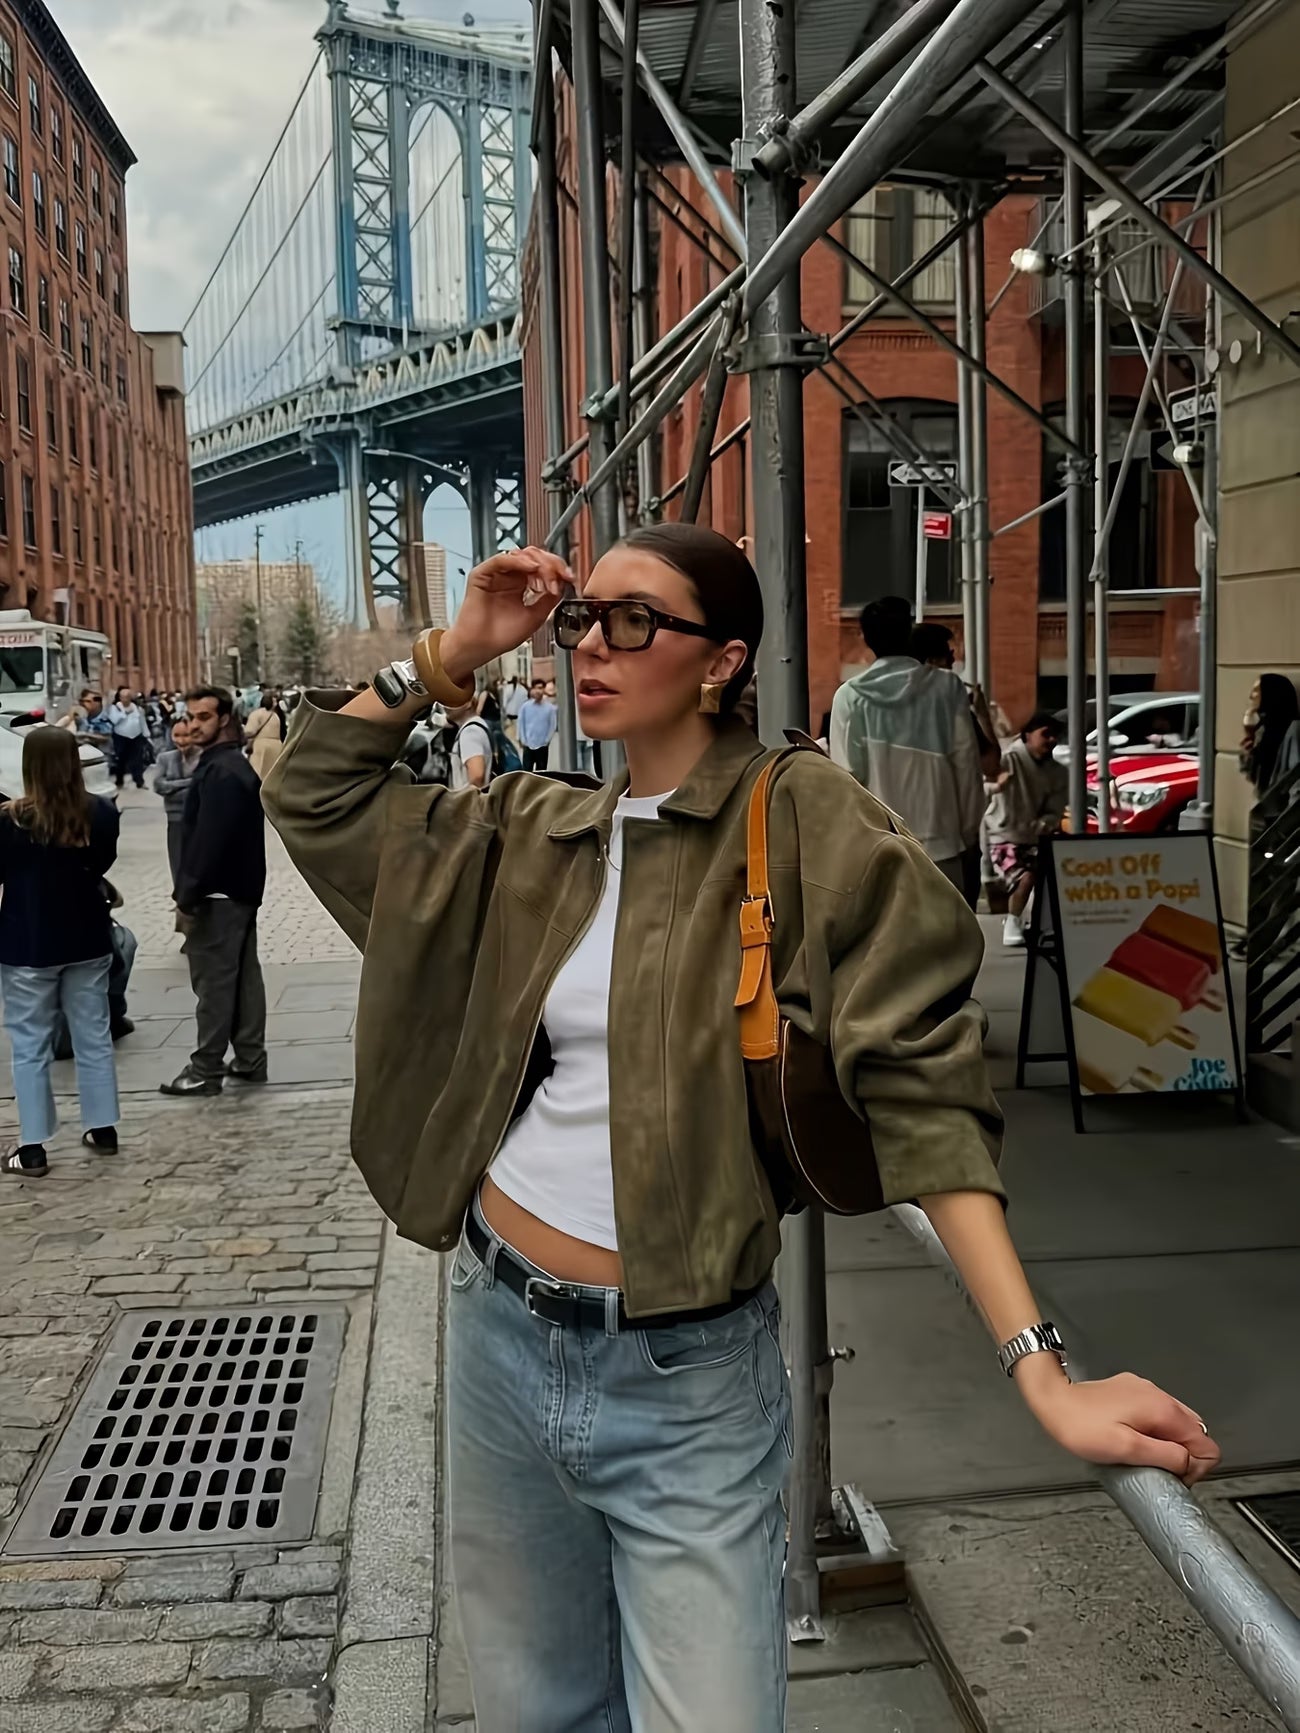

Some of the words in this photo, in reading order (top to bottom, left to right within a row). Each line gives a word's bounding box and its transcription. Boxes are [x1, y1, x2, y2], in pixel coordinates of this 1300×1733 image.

[1061, 857, 1113, 877] Cool
[1120, 852, 1161, 875] Off
[1065, 880, 1119, 902] with
[1126, 885, 1140, 899] a
[1188, 1058, 1226, 1079] Joe
